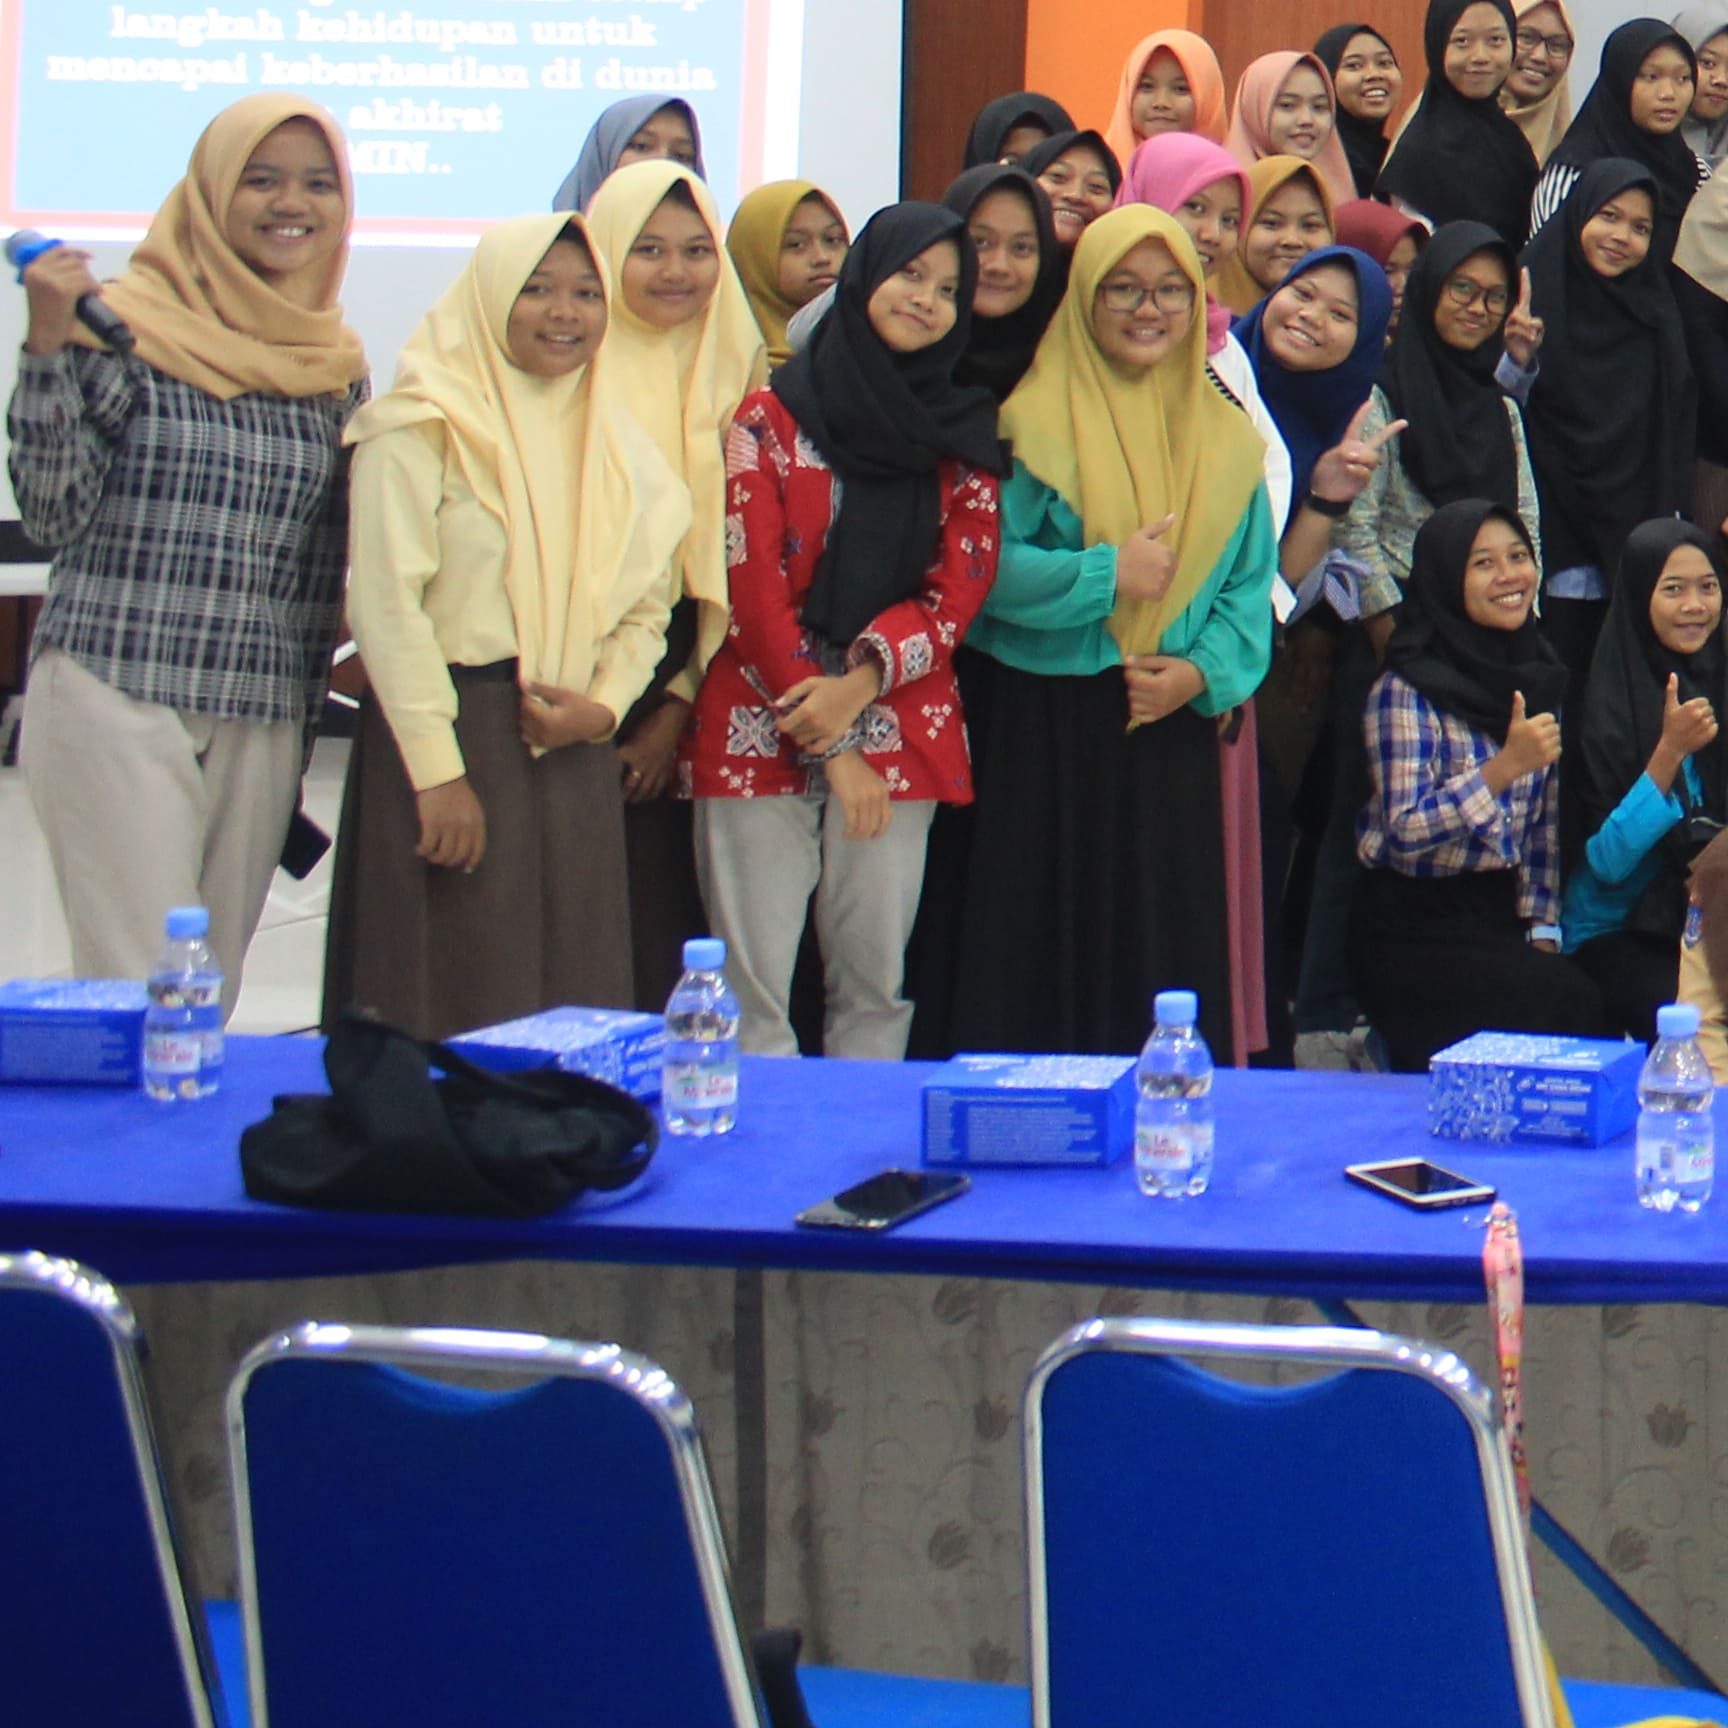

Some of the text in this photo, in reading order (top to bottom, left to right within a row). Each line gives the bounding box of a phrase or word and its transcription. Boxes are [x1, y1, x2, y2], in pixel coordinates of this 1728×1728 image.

[108, 5, 657, 53] langkah kehidupan untuk
[540, 56, 584, 89] di
[593, 57, 717, 91] dunia
[347, 97, 503, 132] akhirat
